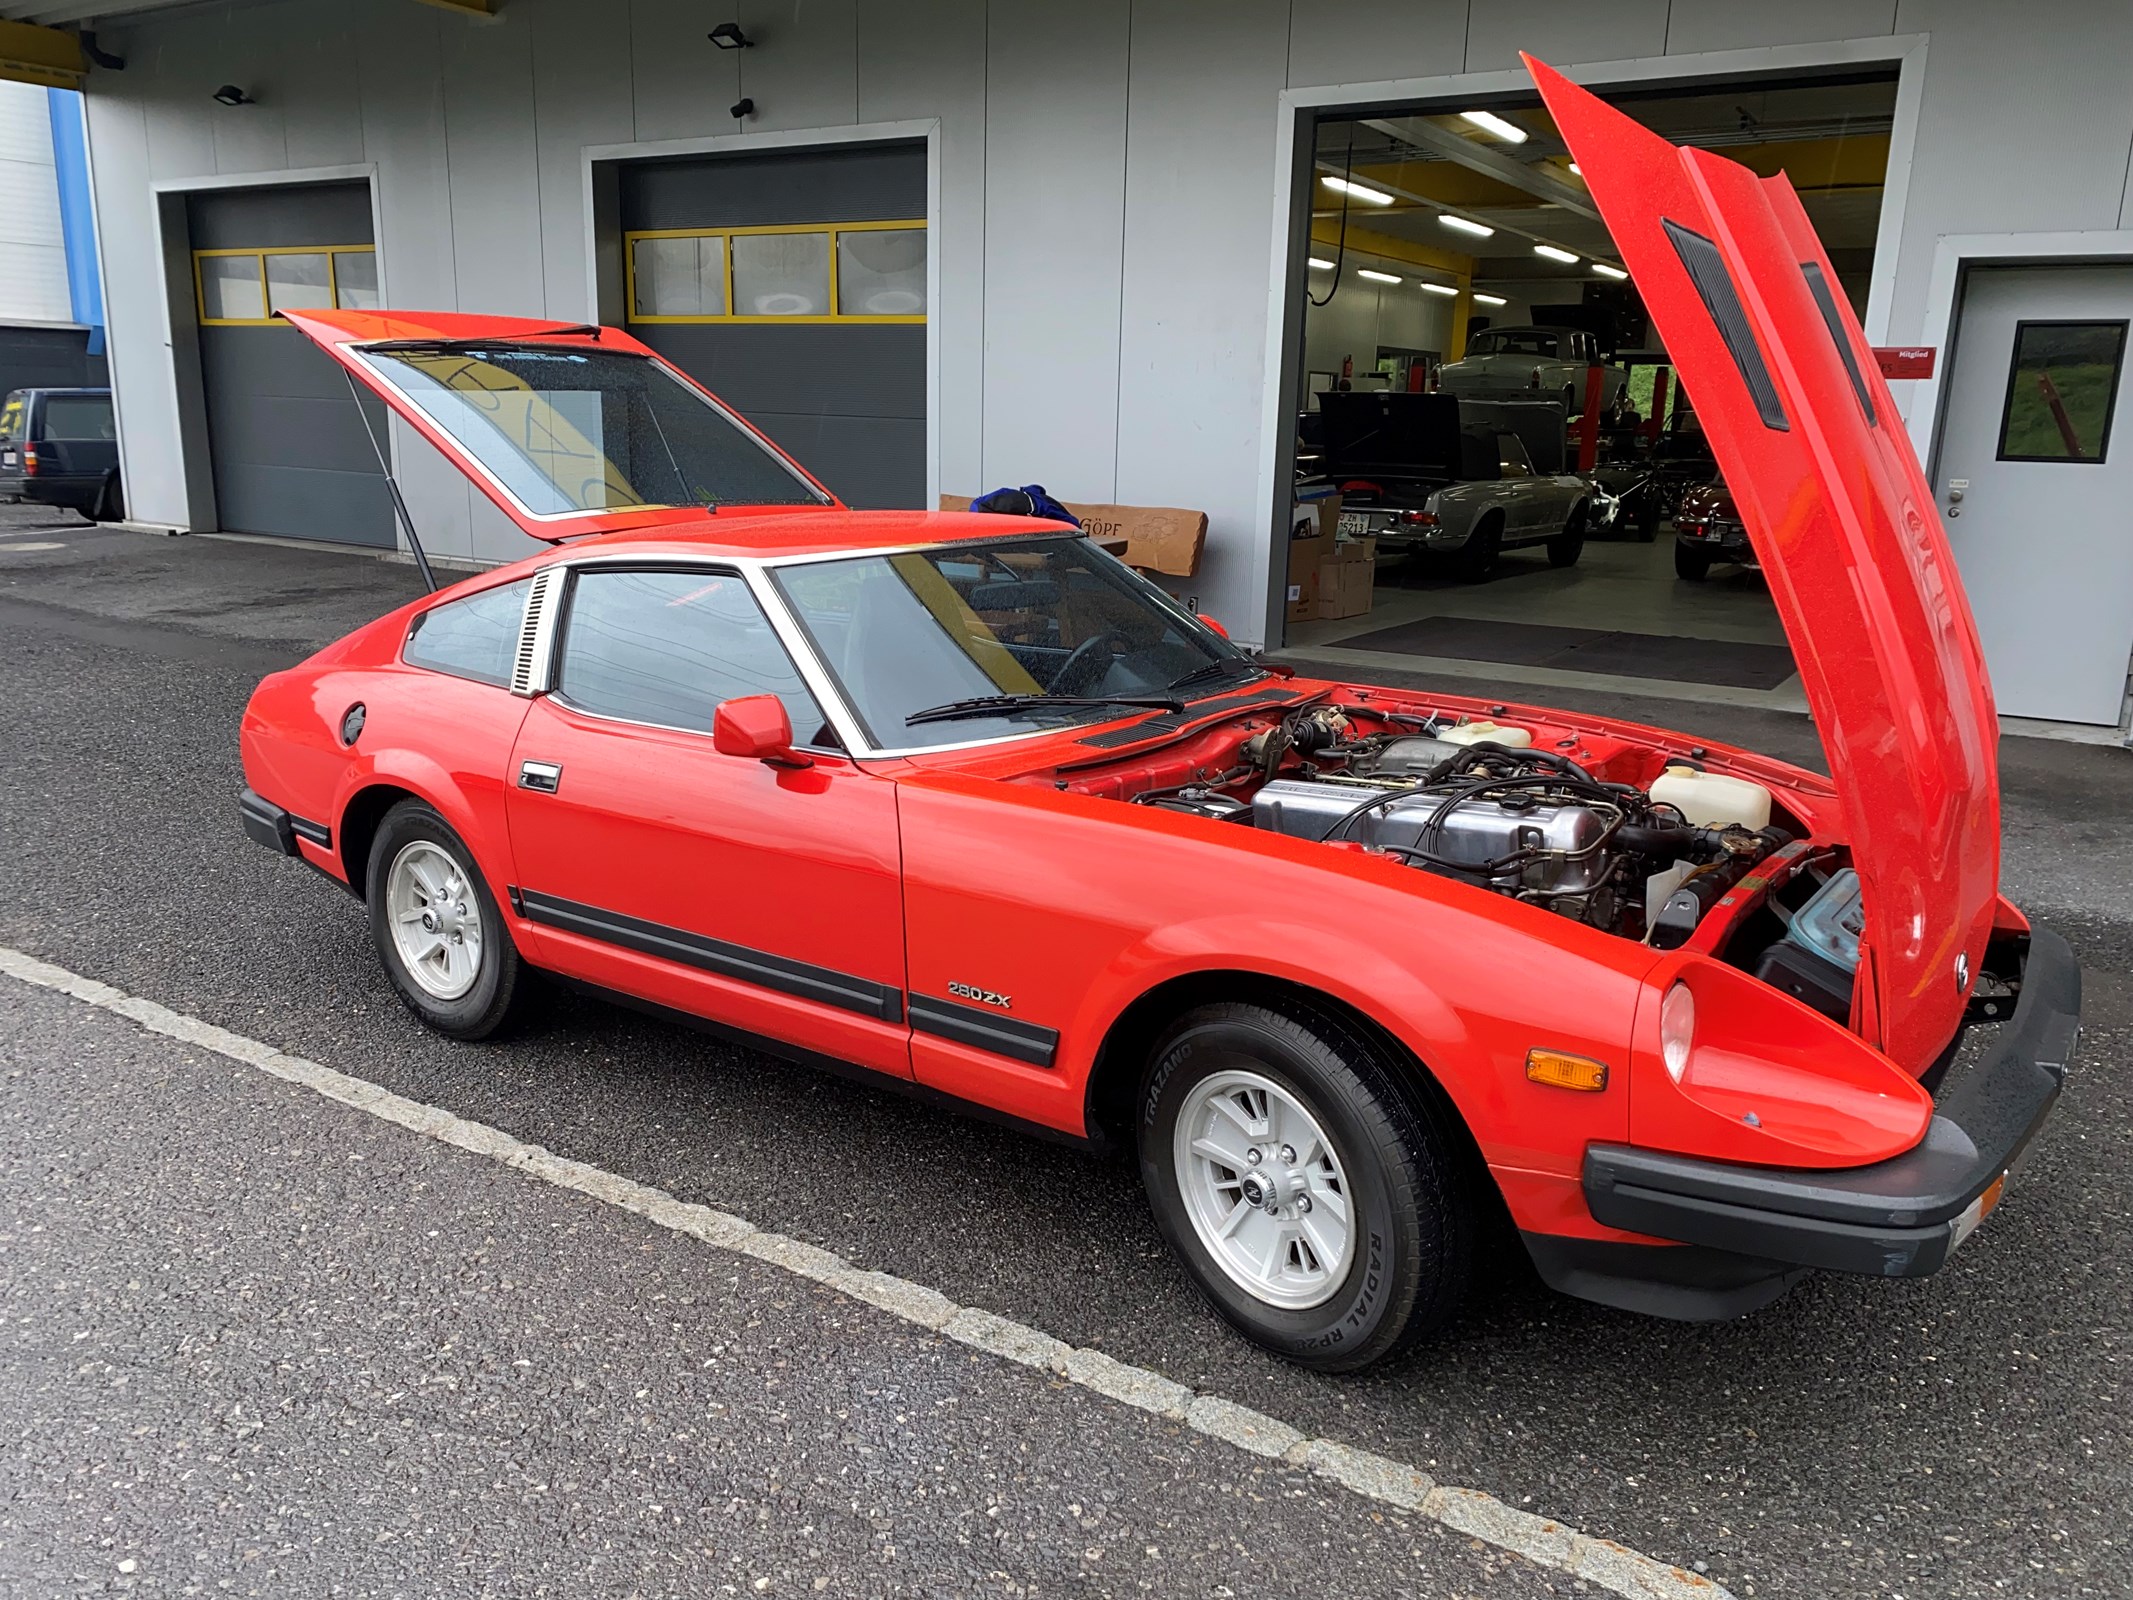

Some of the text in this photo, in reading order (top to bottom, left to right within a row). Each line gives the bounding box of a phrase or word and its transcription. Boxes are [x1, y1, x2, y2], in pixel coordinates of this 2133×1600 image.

[1899, 350, 1928, 359] Mitglied
[1881, 363, 1893, 373] FS
[1080, 518, 1122, 536] GÖPF
[1347, 514, 1357, 522] ZH
[948, 981, 1012, 1008] 280ZX
[1144, 1043, 1193, 1126] TRAZANO
[1346, 1232, 1382, 1327] RADIAL
